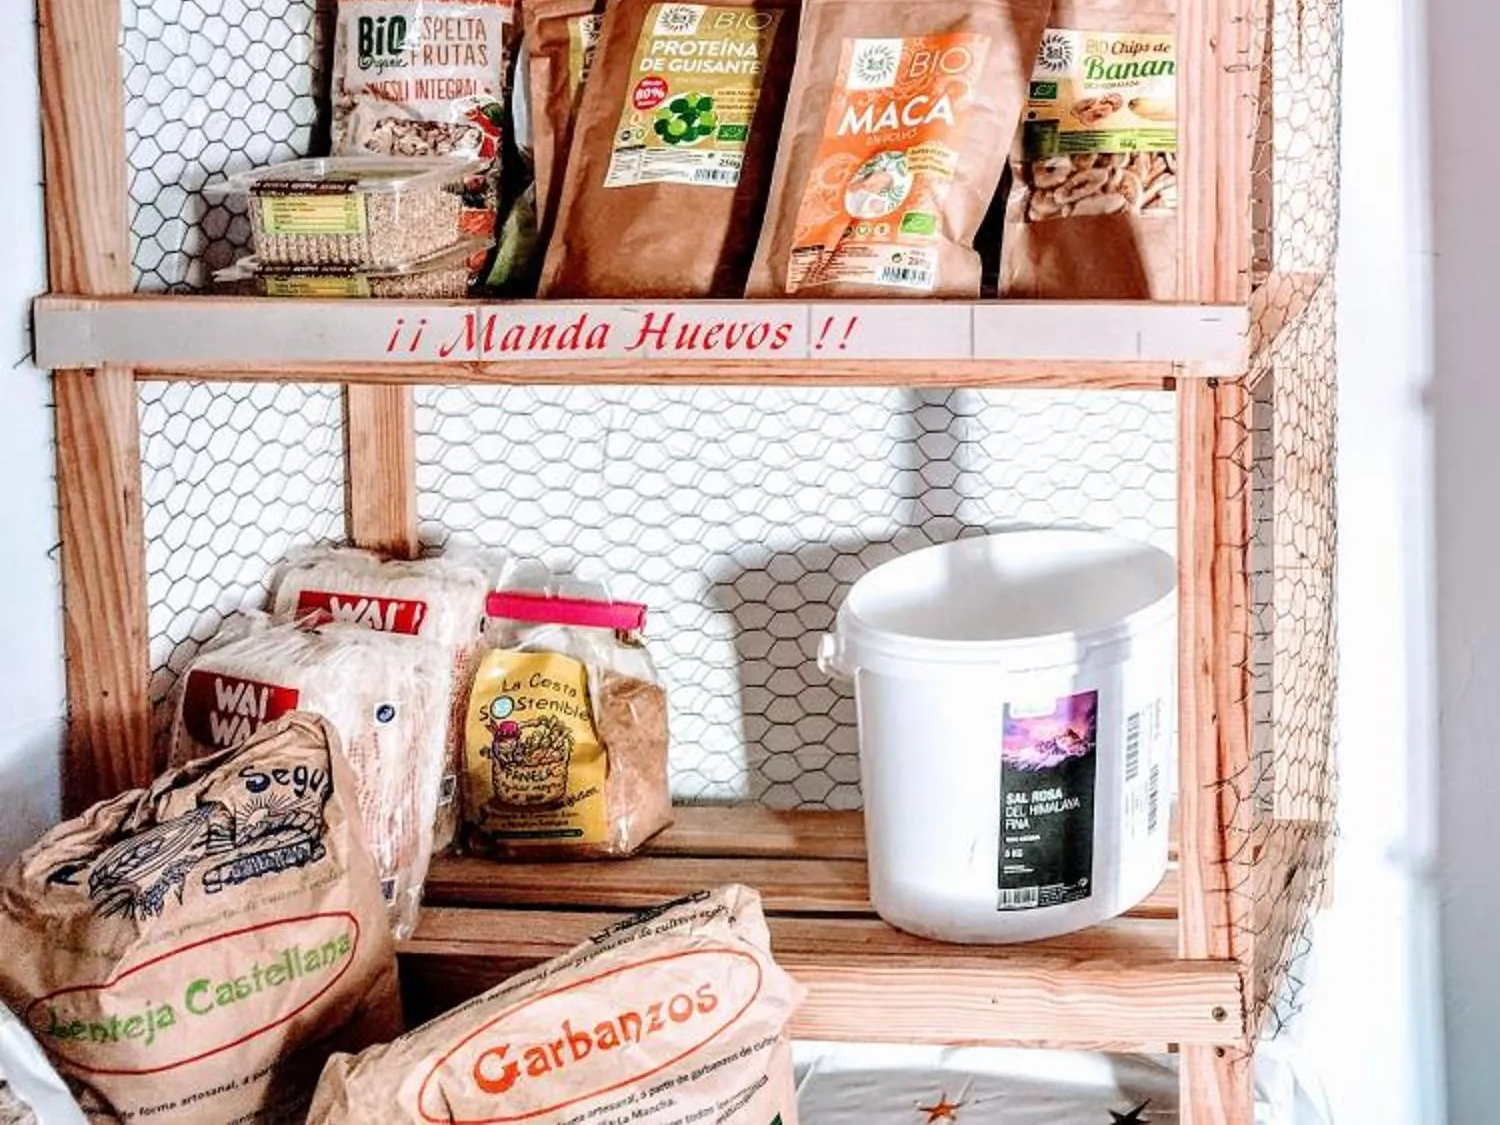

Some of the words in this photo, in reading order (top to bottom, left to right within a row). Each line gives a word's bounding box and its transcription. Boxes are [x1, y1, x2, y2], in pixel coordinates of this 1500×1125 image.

[414, 15, 488, 41] SPELTA
[714, 11, 773, 31] BIO
[411, 43, 489, 67] FRUTAS
[650, 37, 760, 58] PROTEÍNA
[1111, 39, 1150, 57] Chips
[1153, 41, 1171, 53] de
[640, 58, 665, 73] DE
[668, 59, 762, 75] GUISANTE
[908, 47, 973, 78] BIO
[836, 93, 956, 137] MACA
[440, 313, 610, 359] Manda
[624, 312, 794, 352] Huevos
[502, 678, 522, 694] La
[1005, 805, 1027, 819] DEL
[1029, 796, 1081, 817] HIMALAYA
[1006, 792, 1029, 806] SAL
[1031, 787, 1065, 804] ROSA
[1005, 817, 1031, 831] FINA
[183, 933, 351, 1016] Castellana
[471, 980, 721, 1096] Garbanzos
